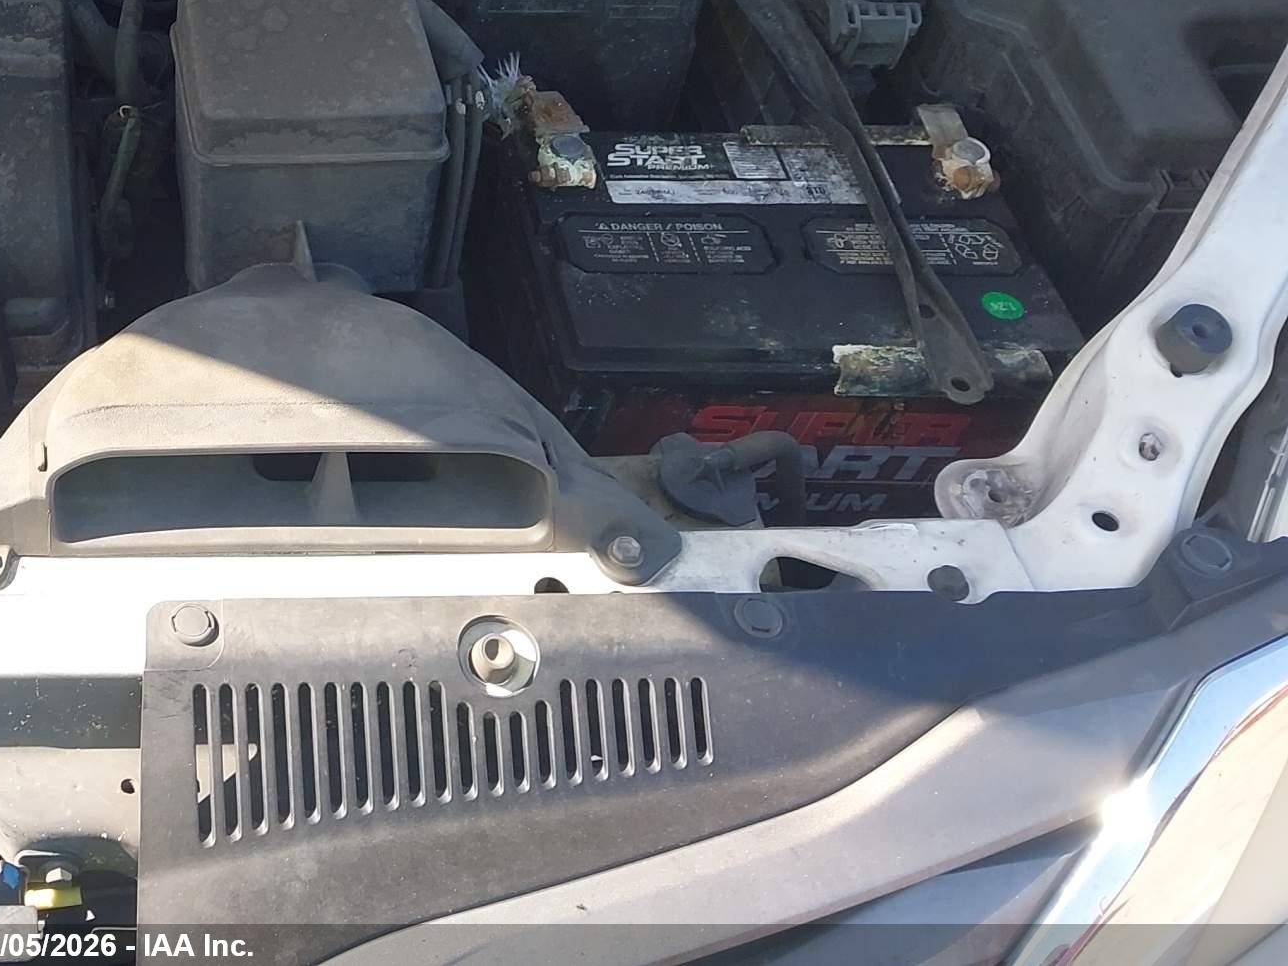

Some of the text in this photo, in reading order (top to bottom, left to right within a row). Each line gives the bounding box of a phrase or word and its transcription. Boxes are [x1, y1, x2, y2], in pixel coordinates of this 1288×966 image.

[614, 143, 704, 155] SUPER
[606, 153, 707, 167] START
[610, 222, 663, 231] DANGER
[675, 222, 723, 231] POISON
[691, 405, 969, 445] SUPER
